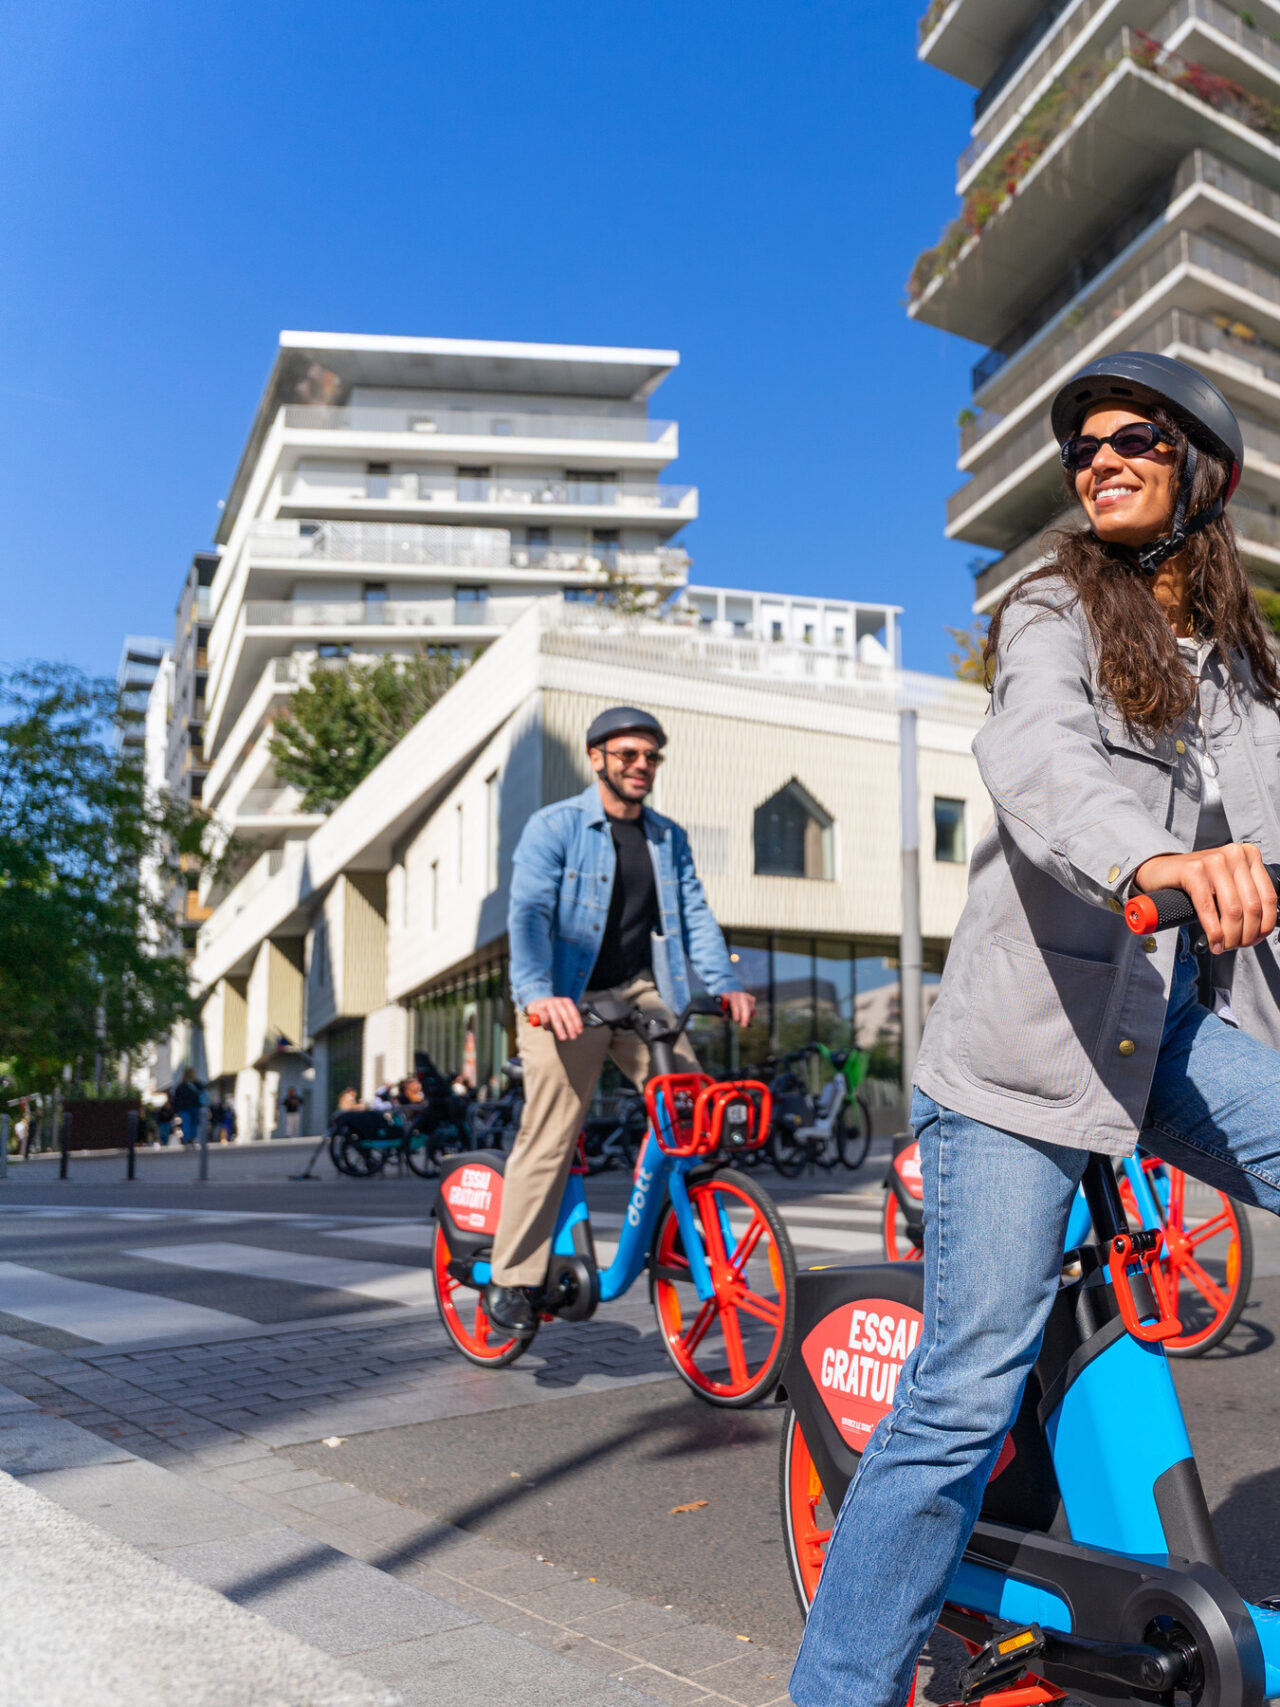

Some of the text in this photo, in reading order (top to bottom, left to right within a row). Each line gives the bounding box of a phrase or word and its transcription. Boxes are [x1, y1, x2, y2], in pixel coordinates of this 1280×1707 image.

[627, 1167, 653, 1227] dott
[848, 1309, 919, 1361] ESSAI
[821, 1347, 903, 1405] GRATUI
